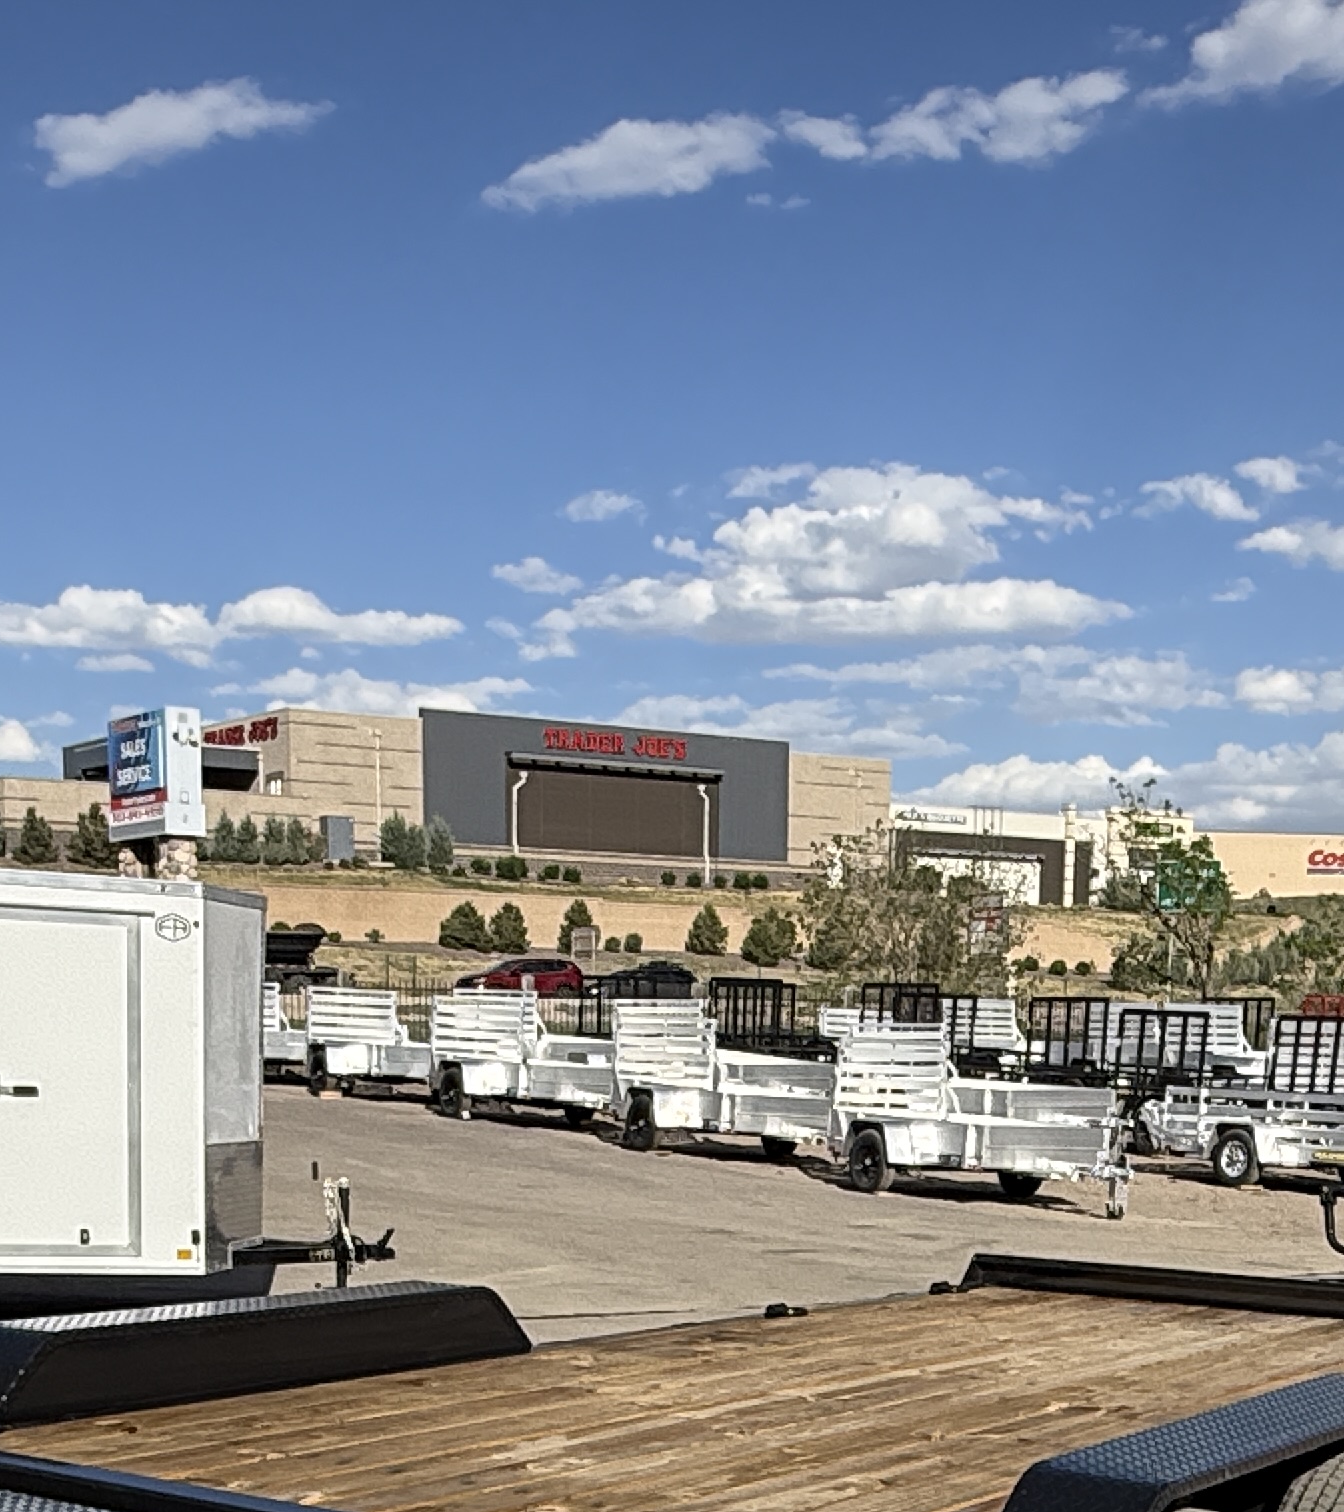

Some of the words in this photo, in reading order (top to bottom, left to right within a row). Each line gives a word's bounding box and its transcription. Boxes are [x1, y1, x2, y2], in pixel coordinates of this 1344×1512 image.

[120, 738, 146, 760] SALES
[543, 727, 625, 755] TRADER
[632, 735, 688, 760] JOE'S
[116, 764, 152, 788] SERVICE
